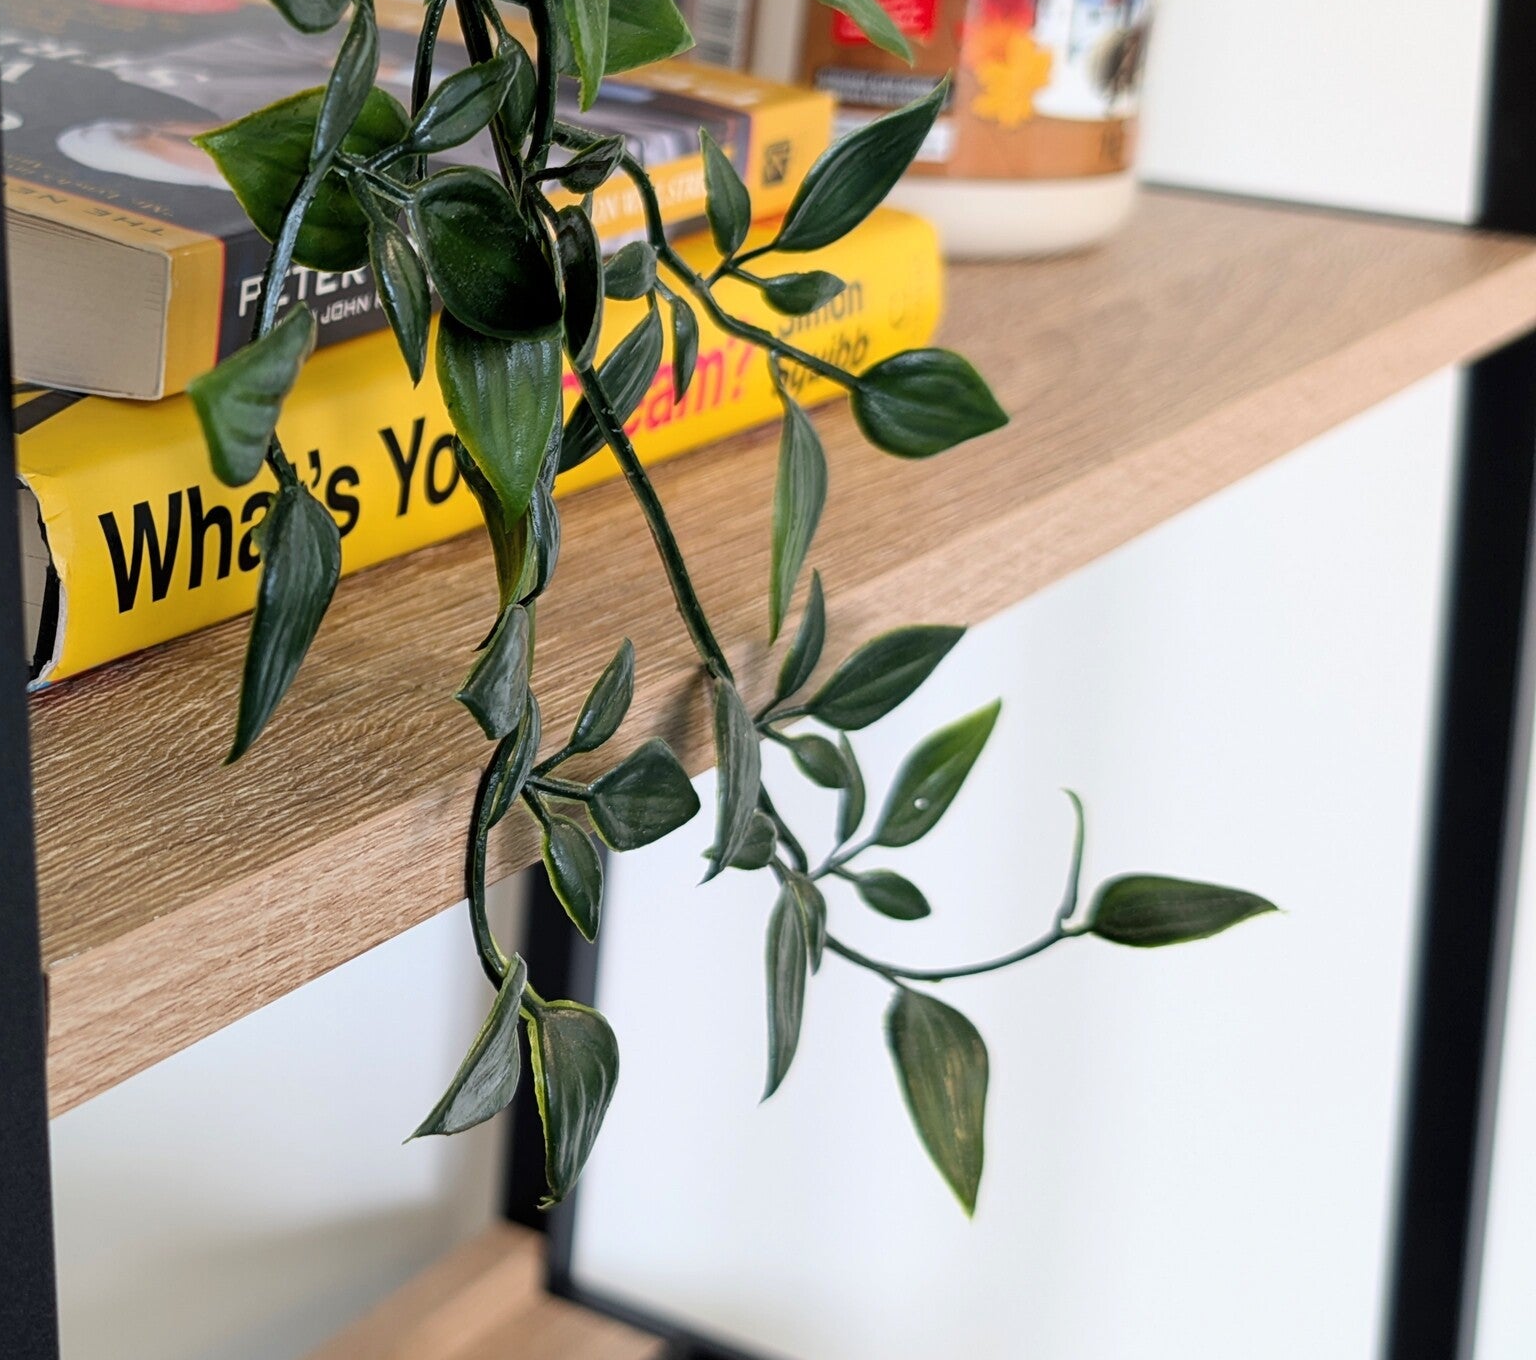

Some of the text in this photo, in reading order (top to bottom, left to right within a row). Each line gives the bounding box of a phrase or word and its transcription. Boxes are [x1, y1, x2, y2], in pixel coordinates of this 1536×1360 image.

[7, 186, 165, 237] THE NE
[320, 296, 370, 325] JOHN
[98, 449, 360, 614] Wha's
